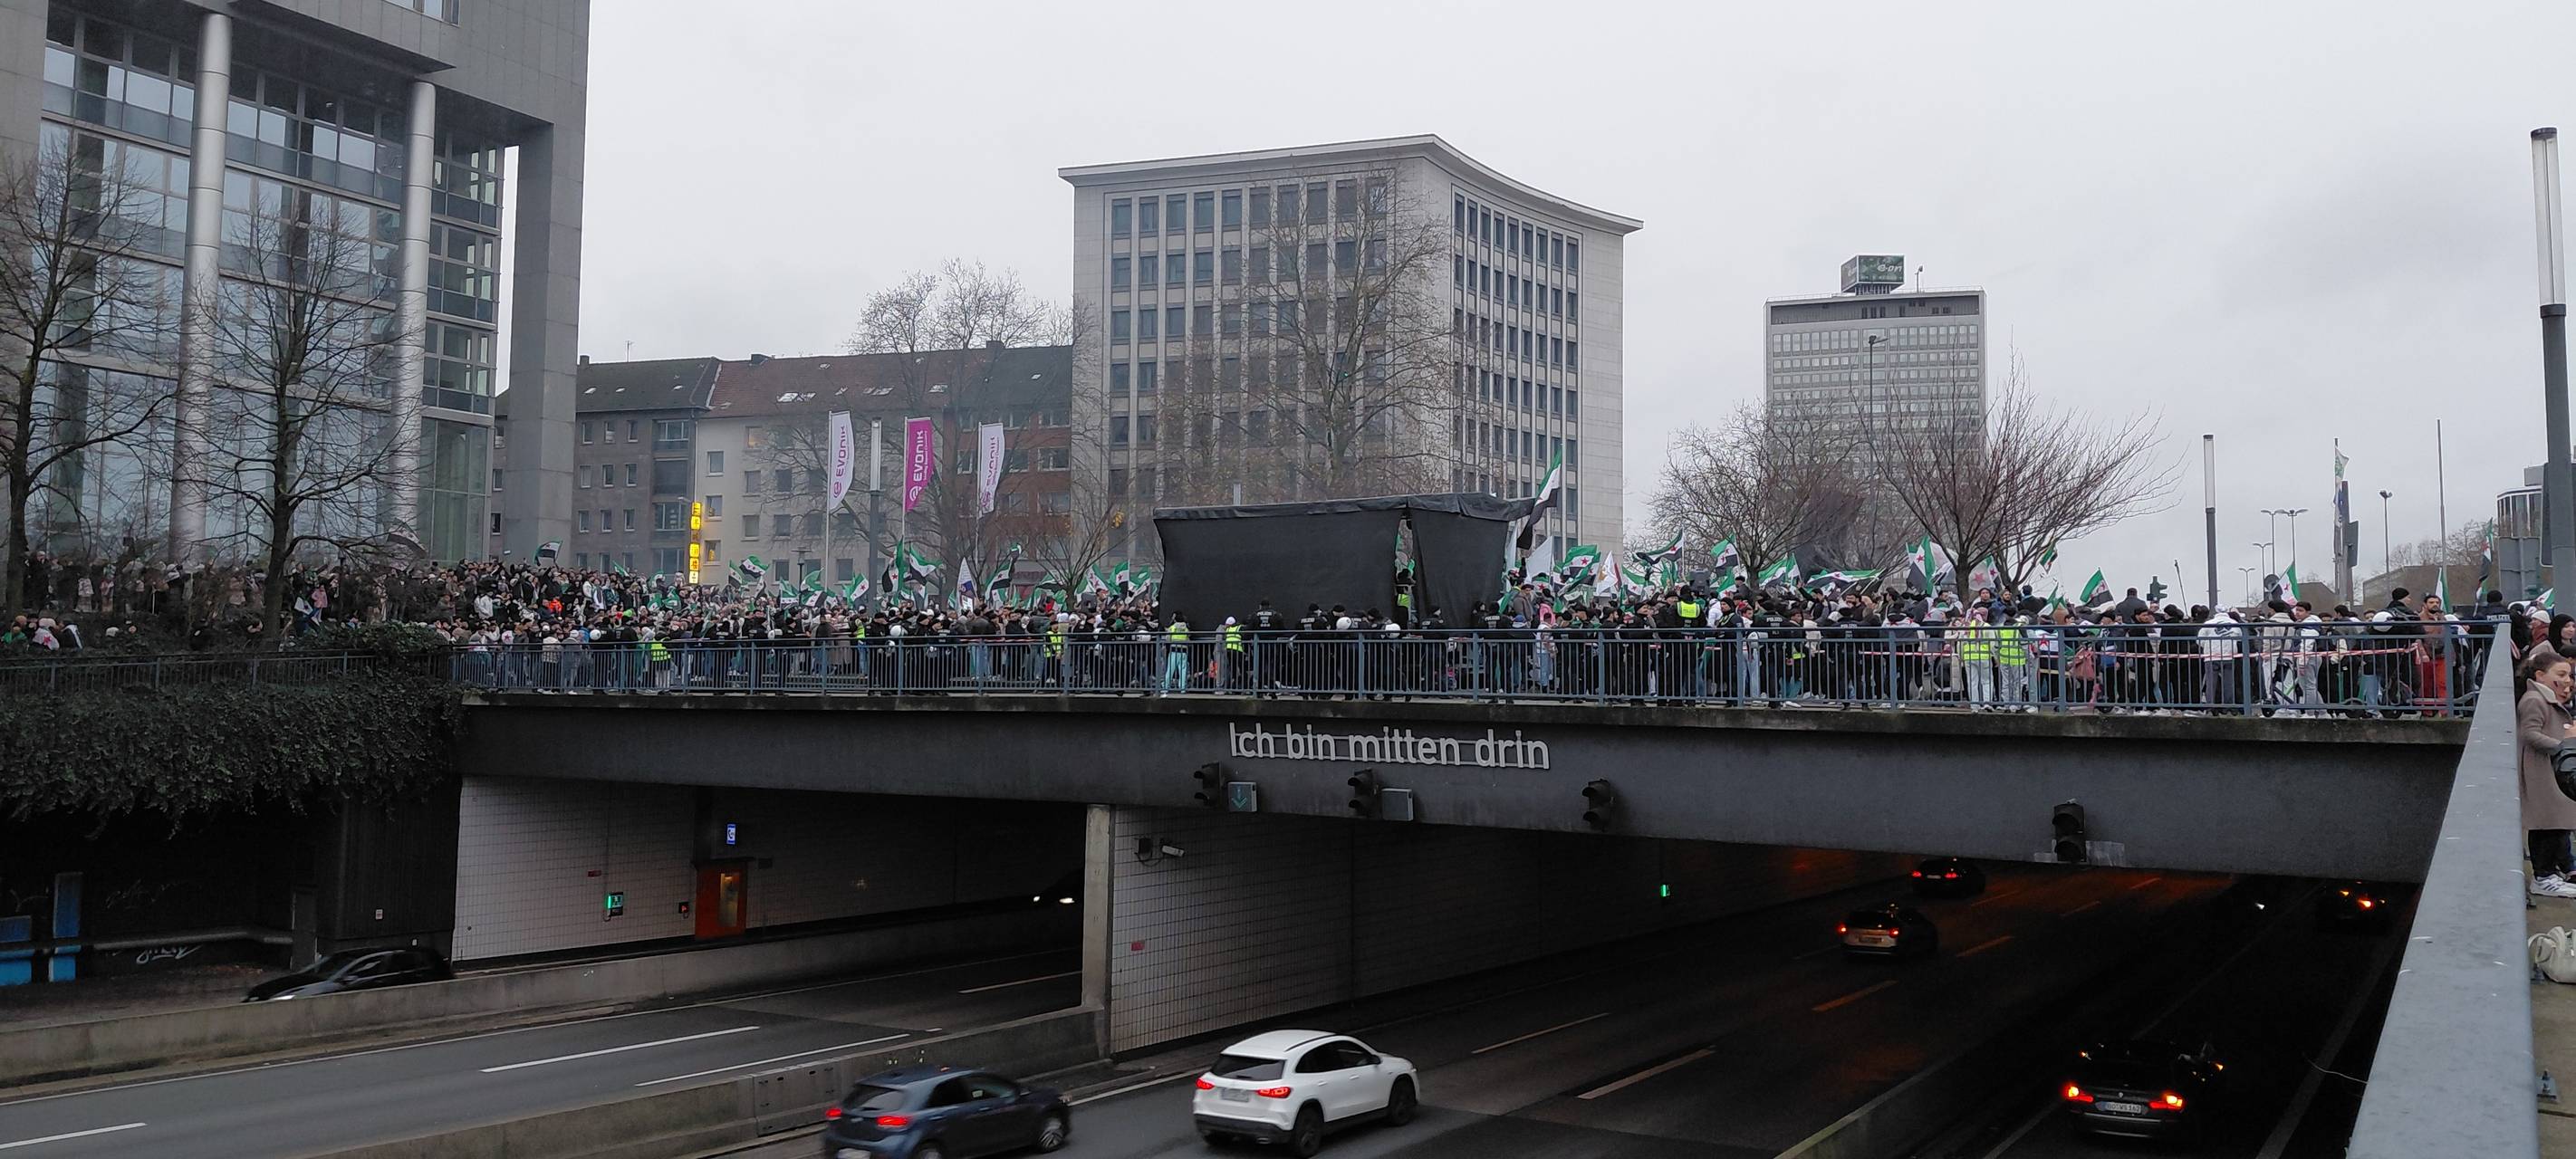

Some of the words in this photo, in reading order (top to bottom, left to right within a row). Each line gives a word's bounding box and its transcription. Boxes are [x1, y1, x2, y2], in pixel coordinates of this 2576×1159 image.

[913, 430, 923, 481] EVONIK
[1229, 723, 1275, 758] Ich
[1285, 723, 1336, 761] bin
[1348, 725, 1461, 765] mitten
[1475, 729, 1550, 770] drin
